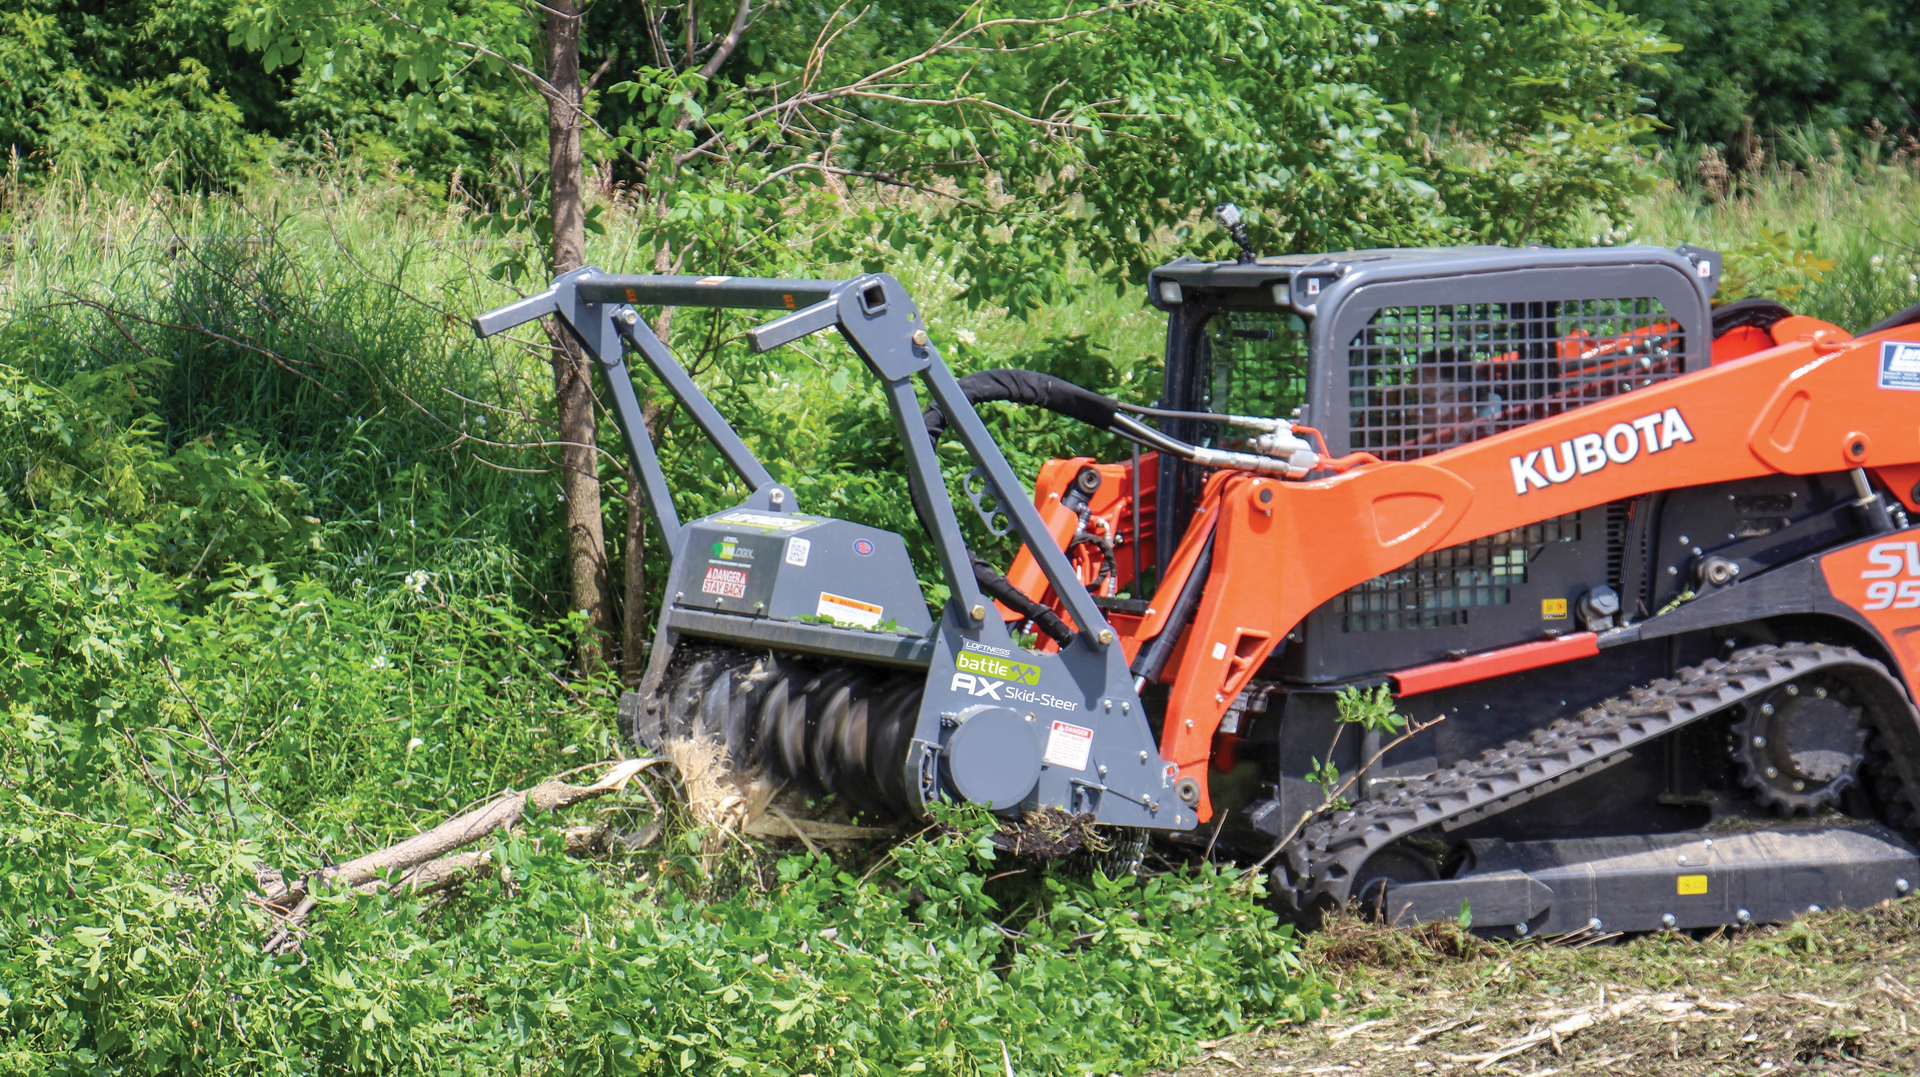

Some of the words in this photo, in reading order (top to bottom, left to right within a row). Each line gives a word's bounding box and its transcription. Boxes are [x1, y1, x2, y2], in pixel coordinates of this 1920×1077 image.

[1510, 407, 1694, 495] KUBOTA
[712, 568, 741, 583] DANGER
[704, 581, 724, 593] STAY
[723, 584, 744, 597] BACK
[1864, 581, 1920, 610] 95
[965, 641, 1011, 657] LOFTNESS
[958, 654, 1008, 677] battle
[951, 672, 1004, 701] AX
[1004, 686, 1078, 712] Skid-Steer
[1064, 725, 1089, 738] DANGER
